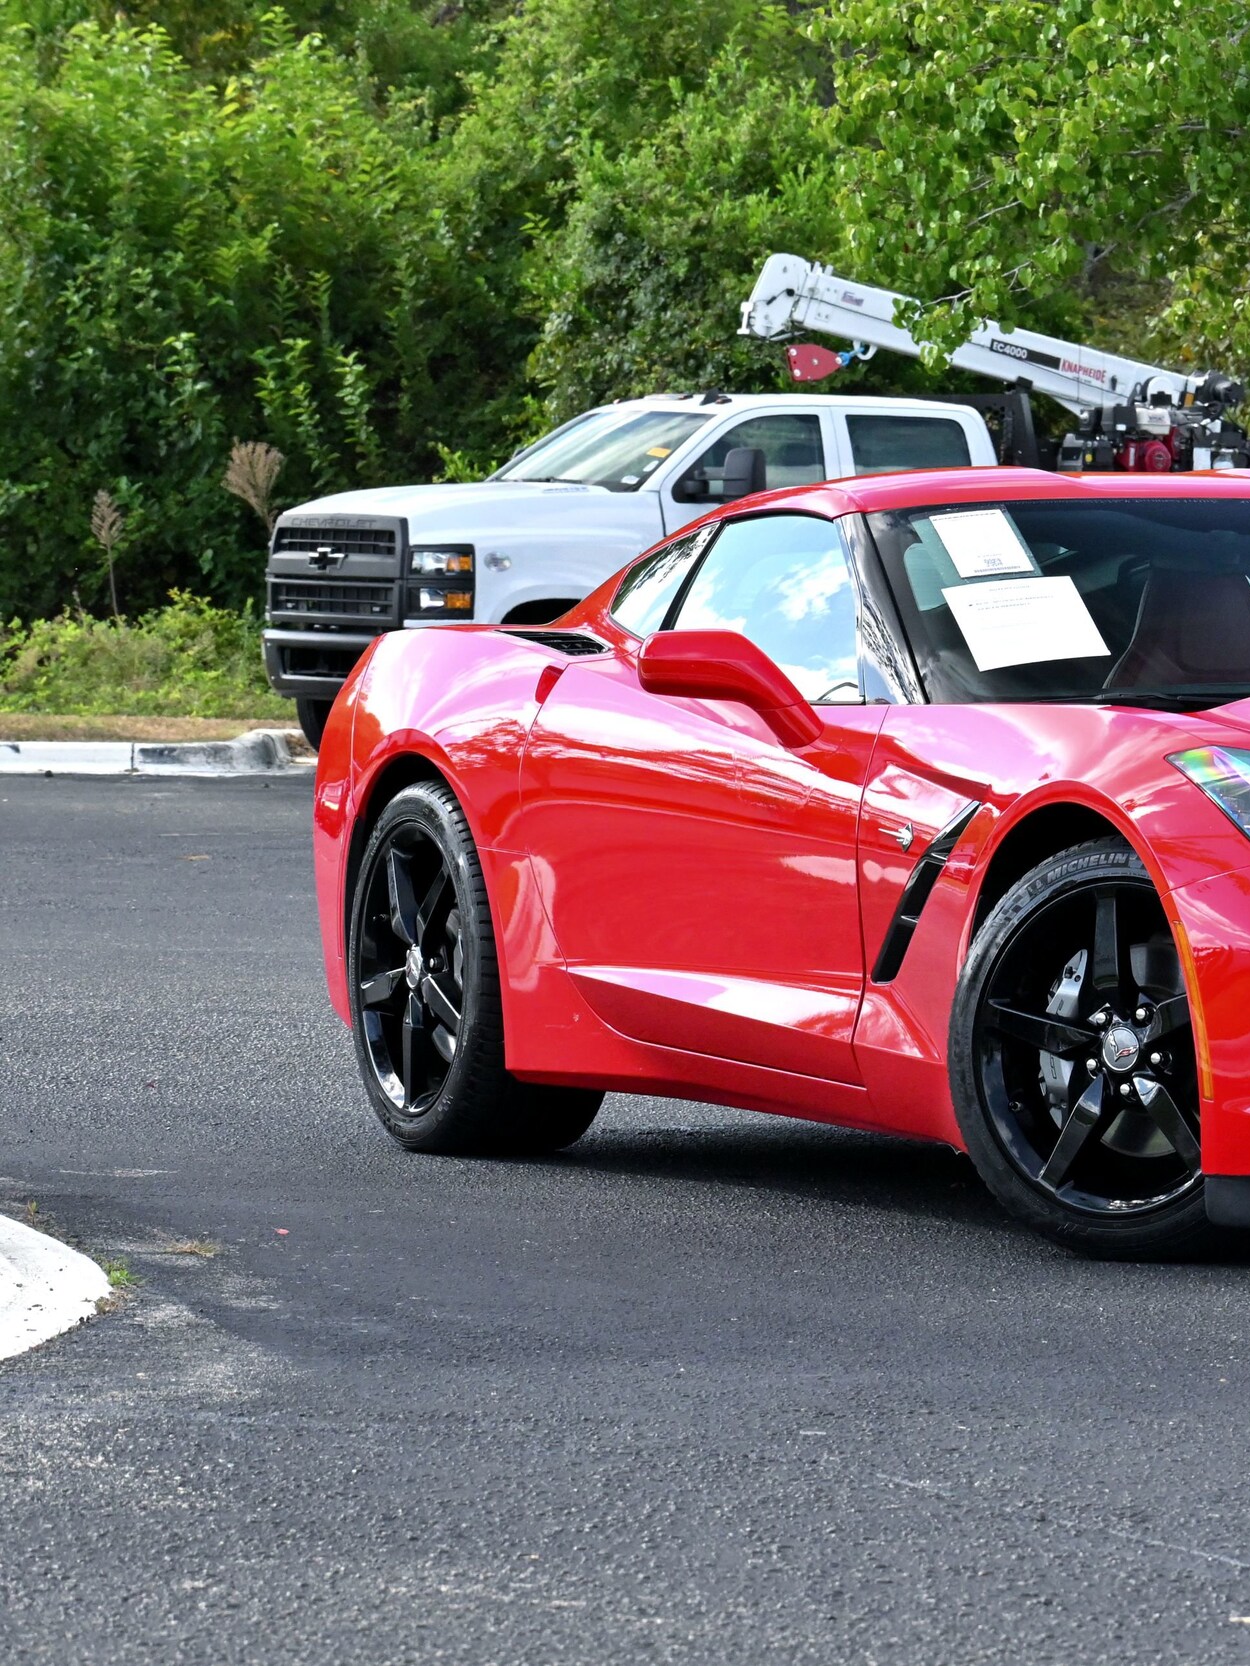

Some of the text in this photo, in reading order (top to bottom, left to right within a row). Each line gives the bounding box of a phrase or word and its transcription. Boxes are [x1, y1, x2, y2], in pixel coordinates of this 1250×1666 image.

[992, 341, 1107, 384] EC4000 KNAPHEIDE
[291, 517, 377, 529] CHEVROLET
[1047, 852, 1129, 883] MICHELIN
